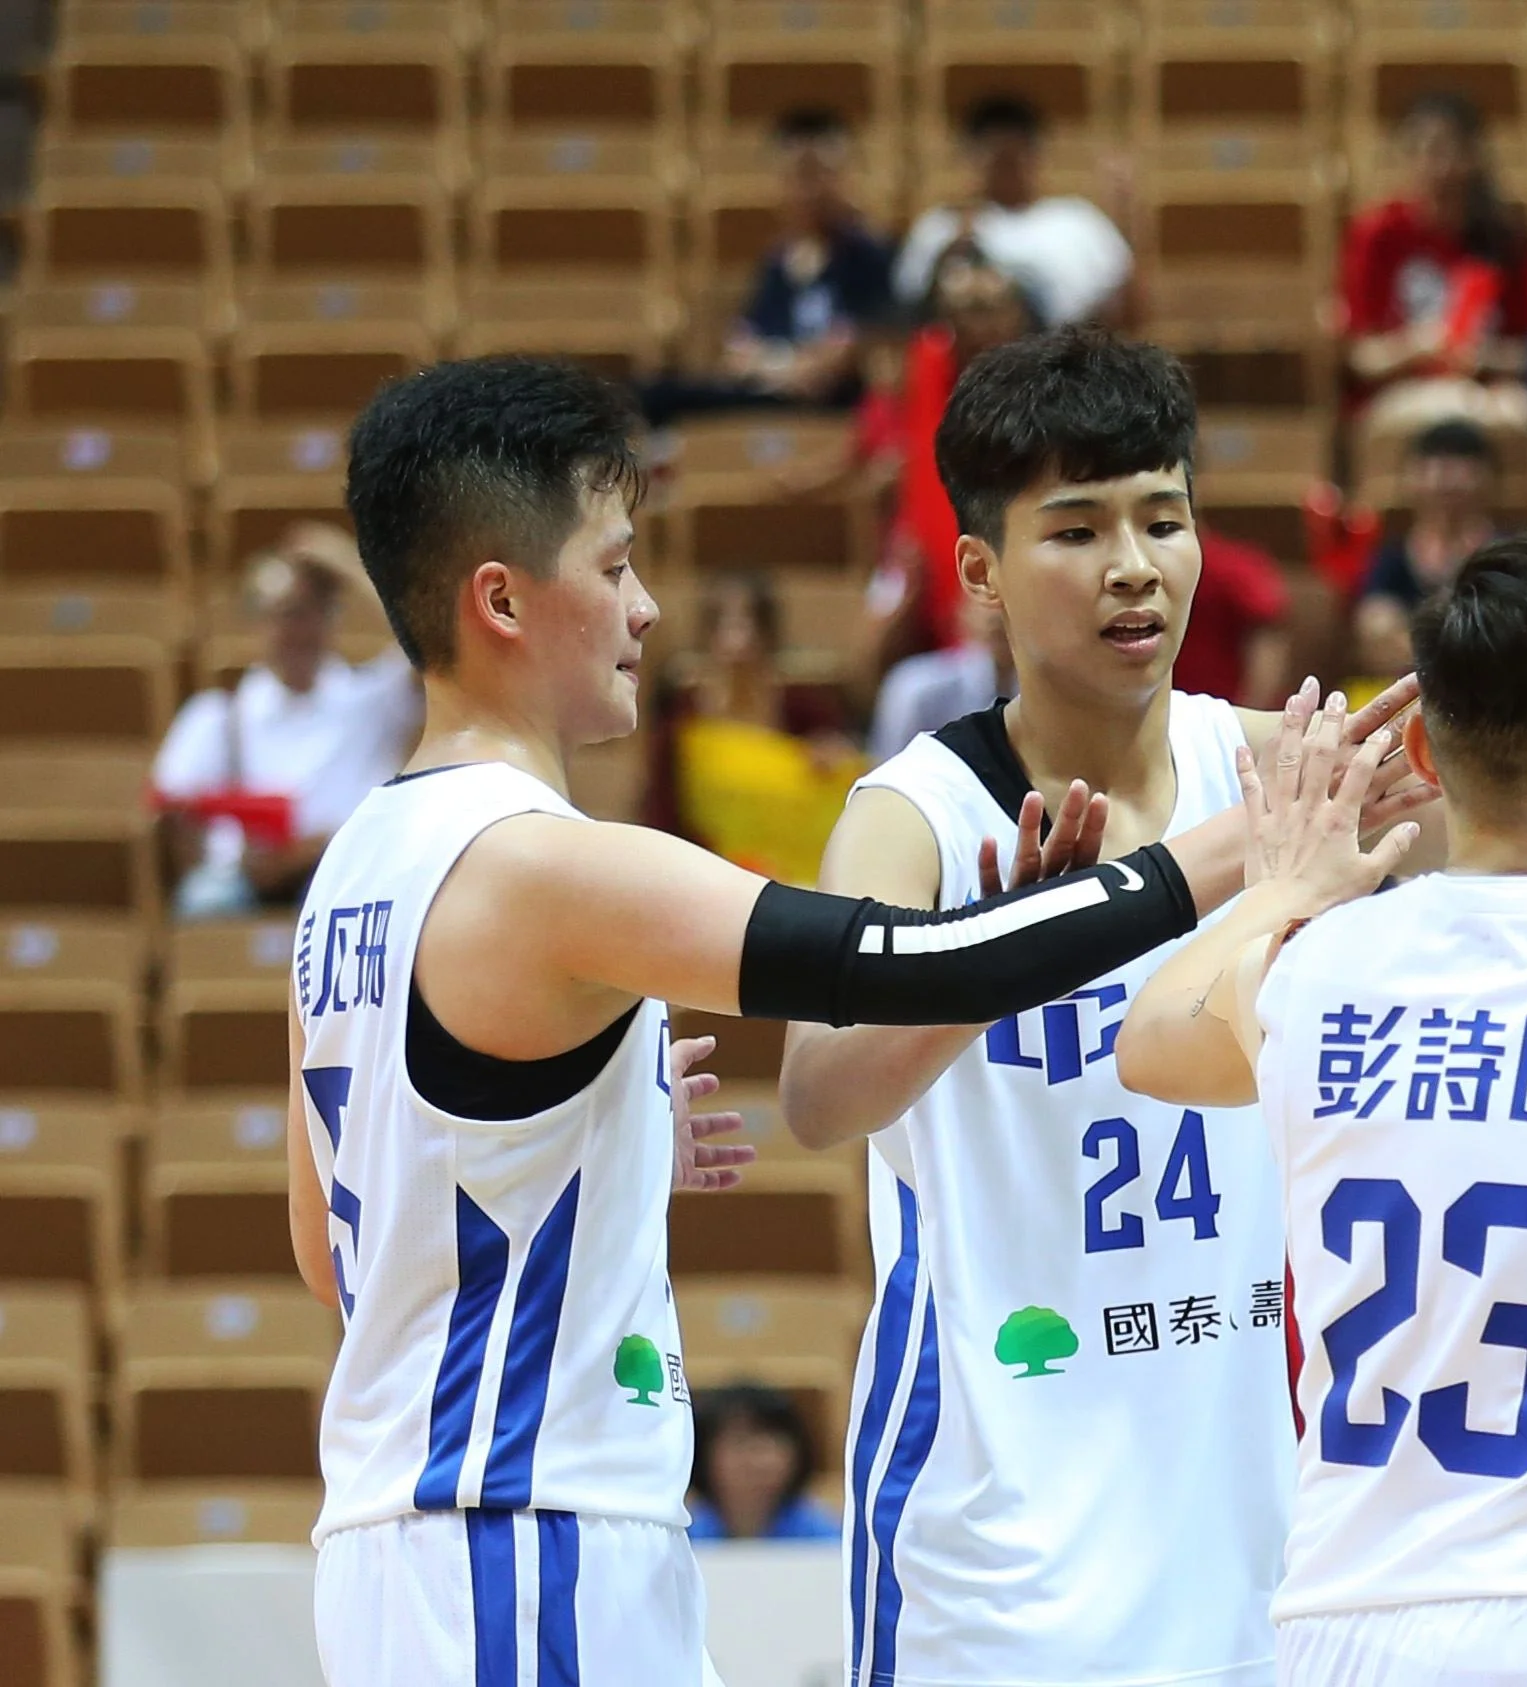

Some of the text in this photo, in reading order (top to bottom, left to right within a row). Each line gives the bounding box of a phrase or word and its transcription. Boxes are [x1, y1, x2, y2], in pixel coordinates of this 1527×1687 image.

[1082, 1108, 1221, 1254] 24
[1103, 1280, 1284, 1356] 國泰壽
